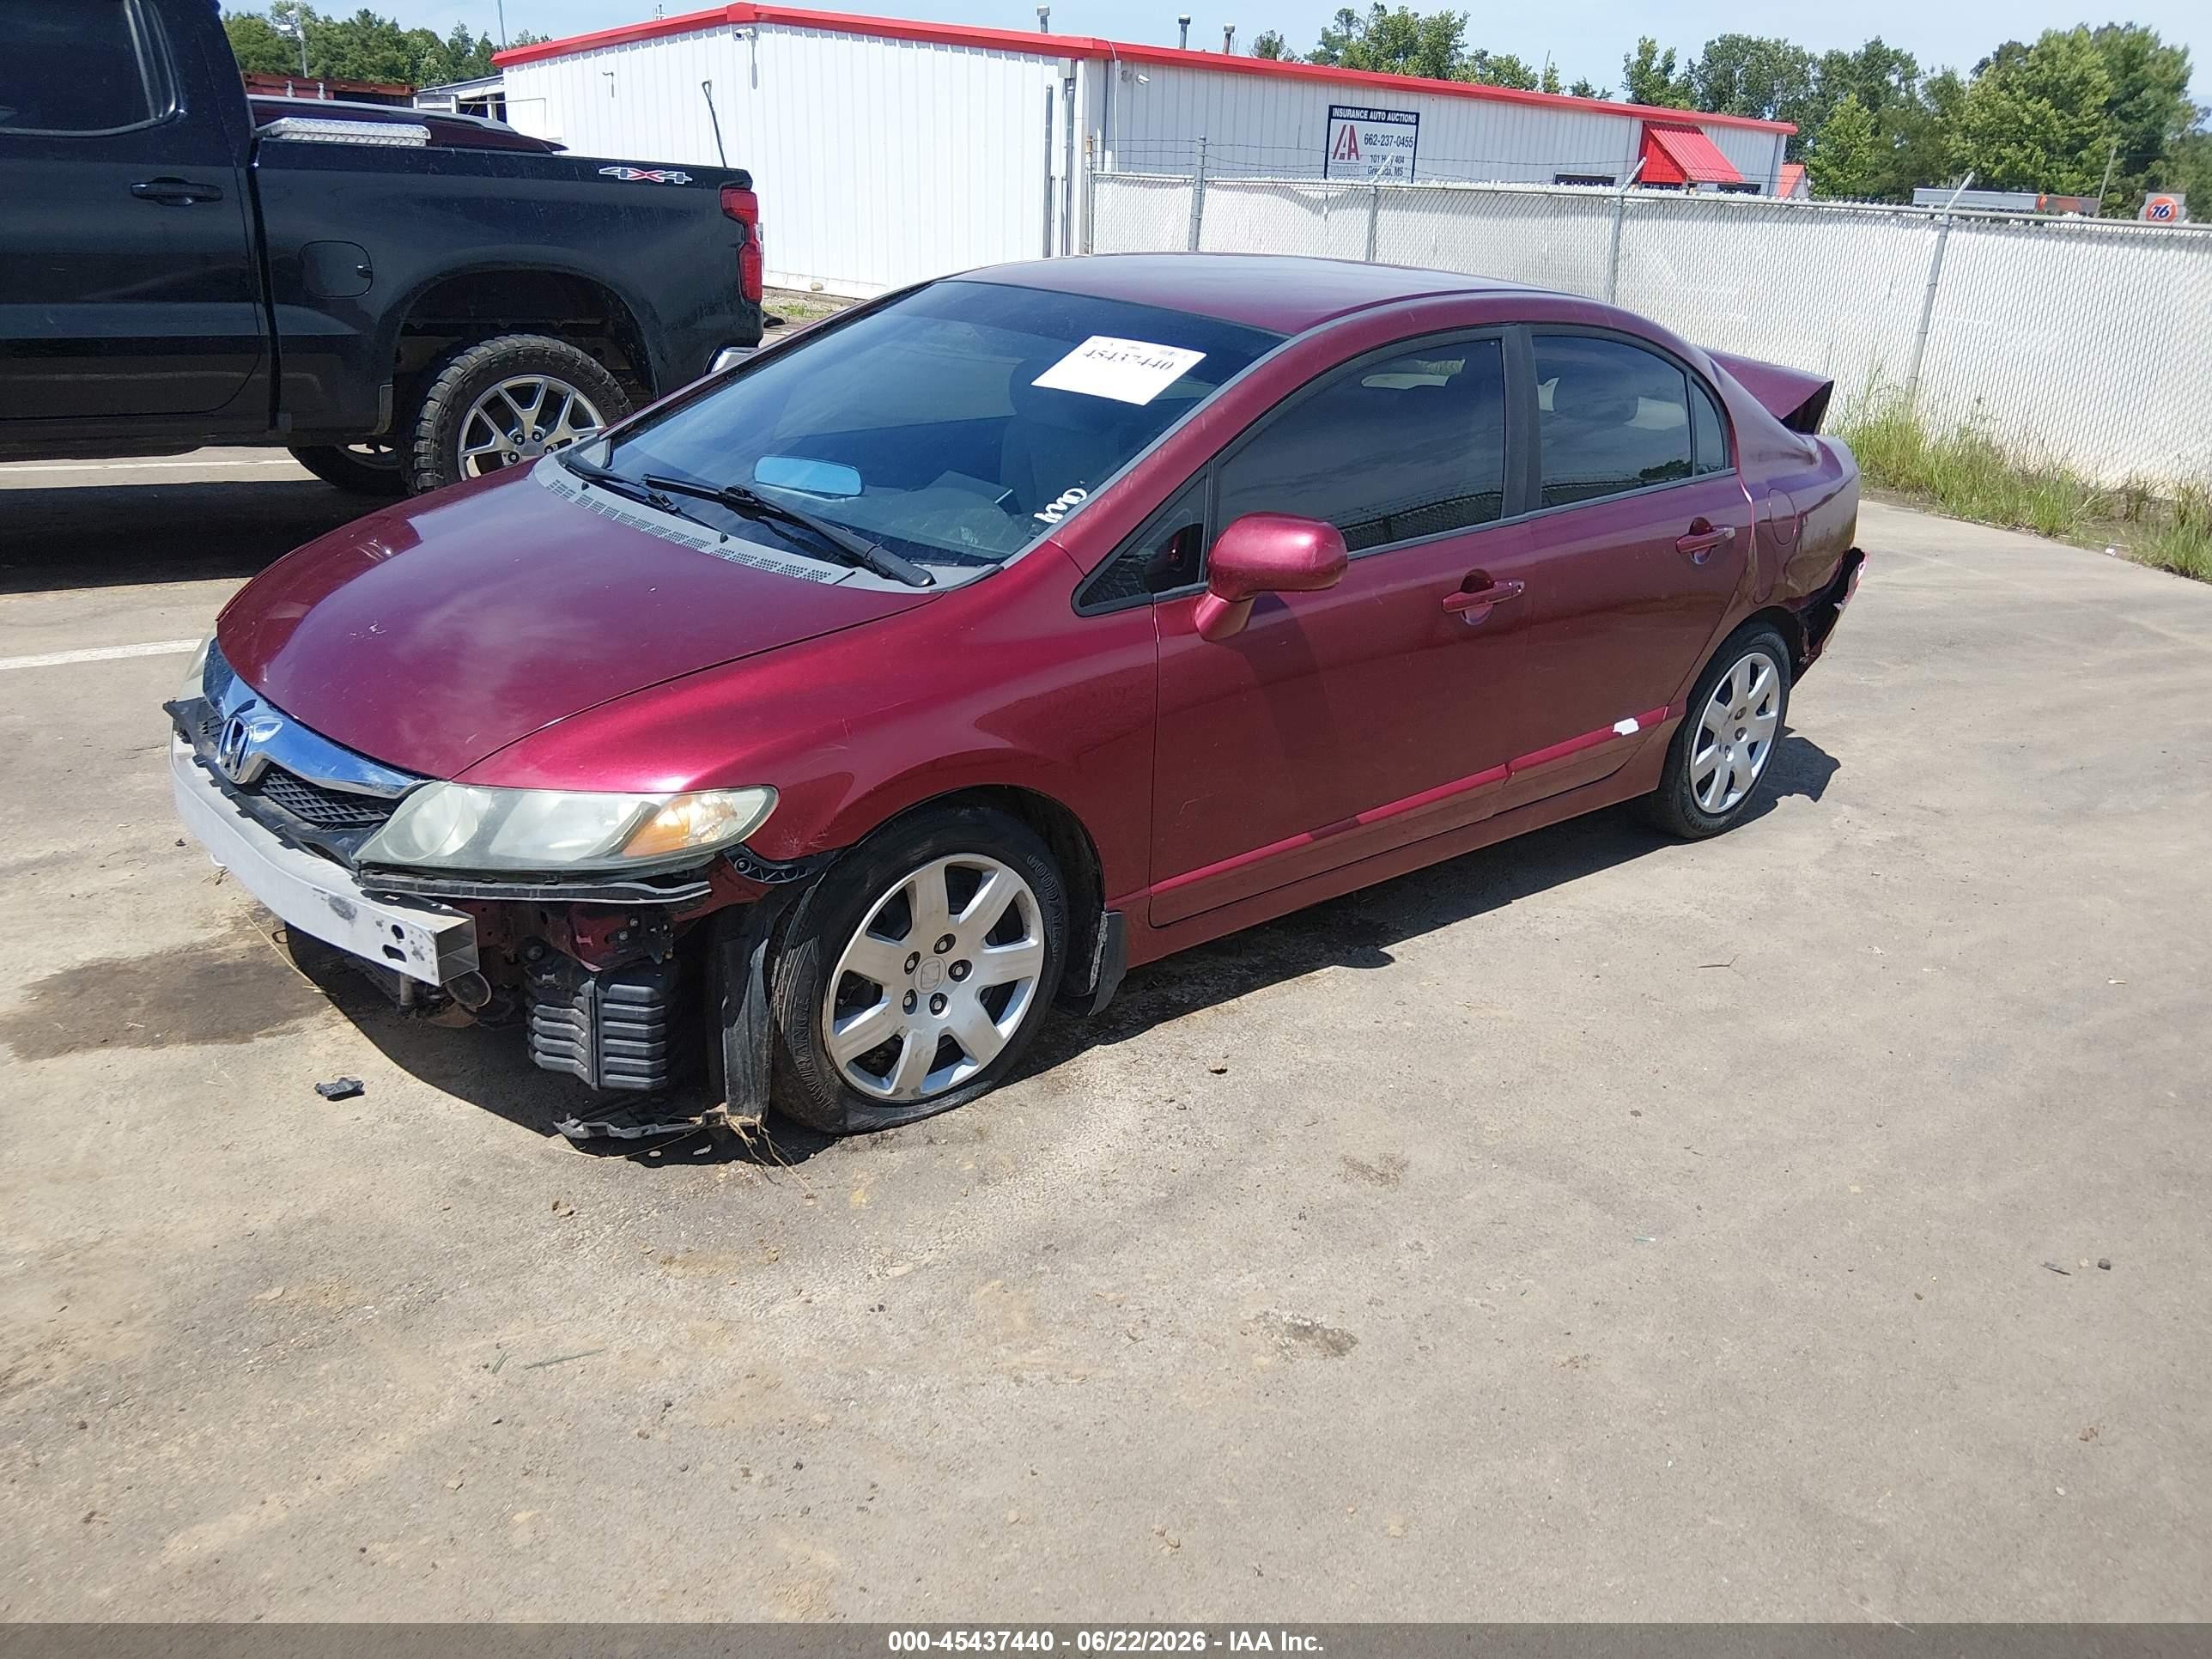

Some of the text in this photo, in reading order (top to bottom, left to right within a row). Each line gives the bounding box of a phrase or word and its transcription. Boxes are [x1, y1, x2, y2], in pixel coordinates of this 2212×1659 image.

[1333, 107, 1417, 124] INSURANCE AUTO AUCTIONS
[1364, 133, 1413, 148] 662-237-0455
[1370, 155, 1380, 163] 101
[1395, 155, 1405, 164] 404
[1394, 167, 1404, 177] MS
[2150, 204, 2171, 219] 76
